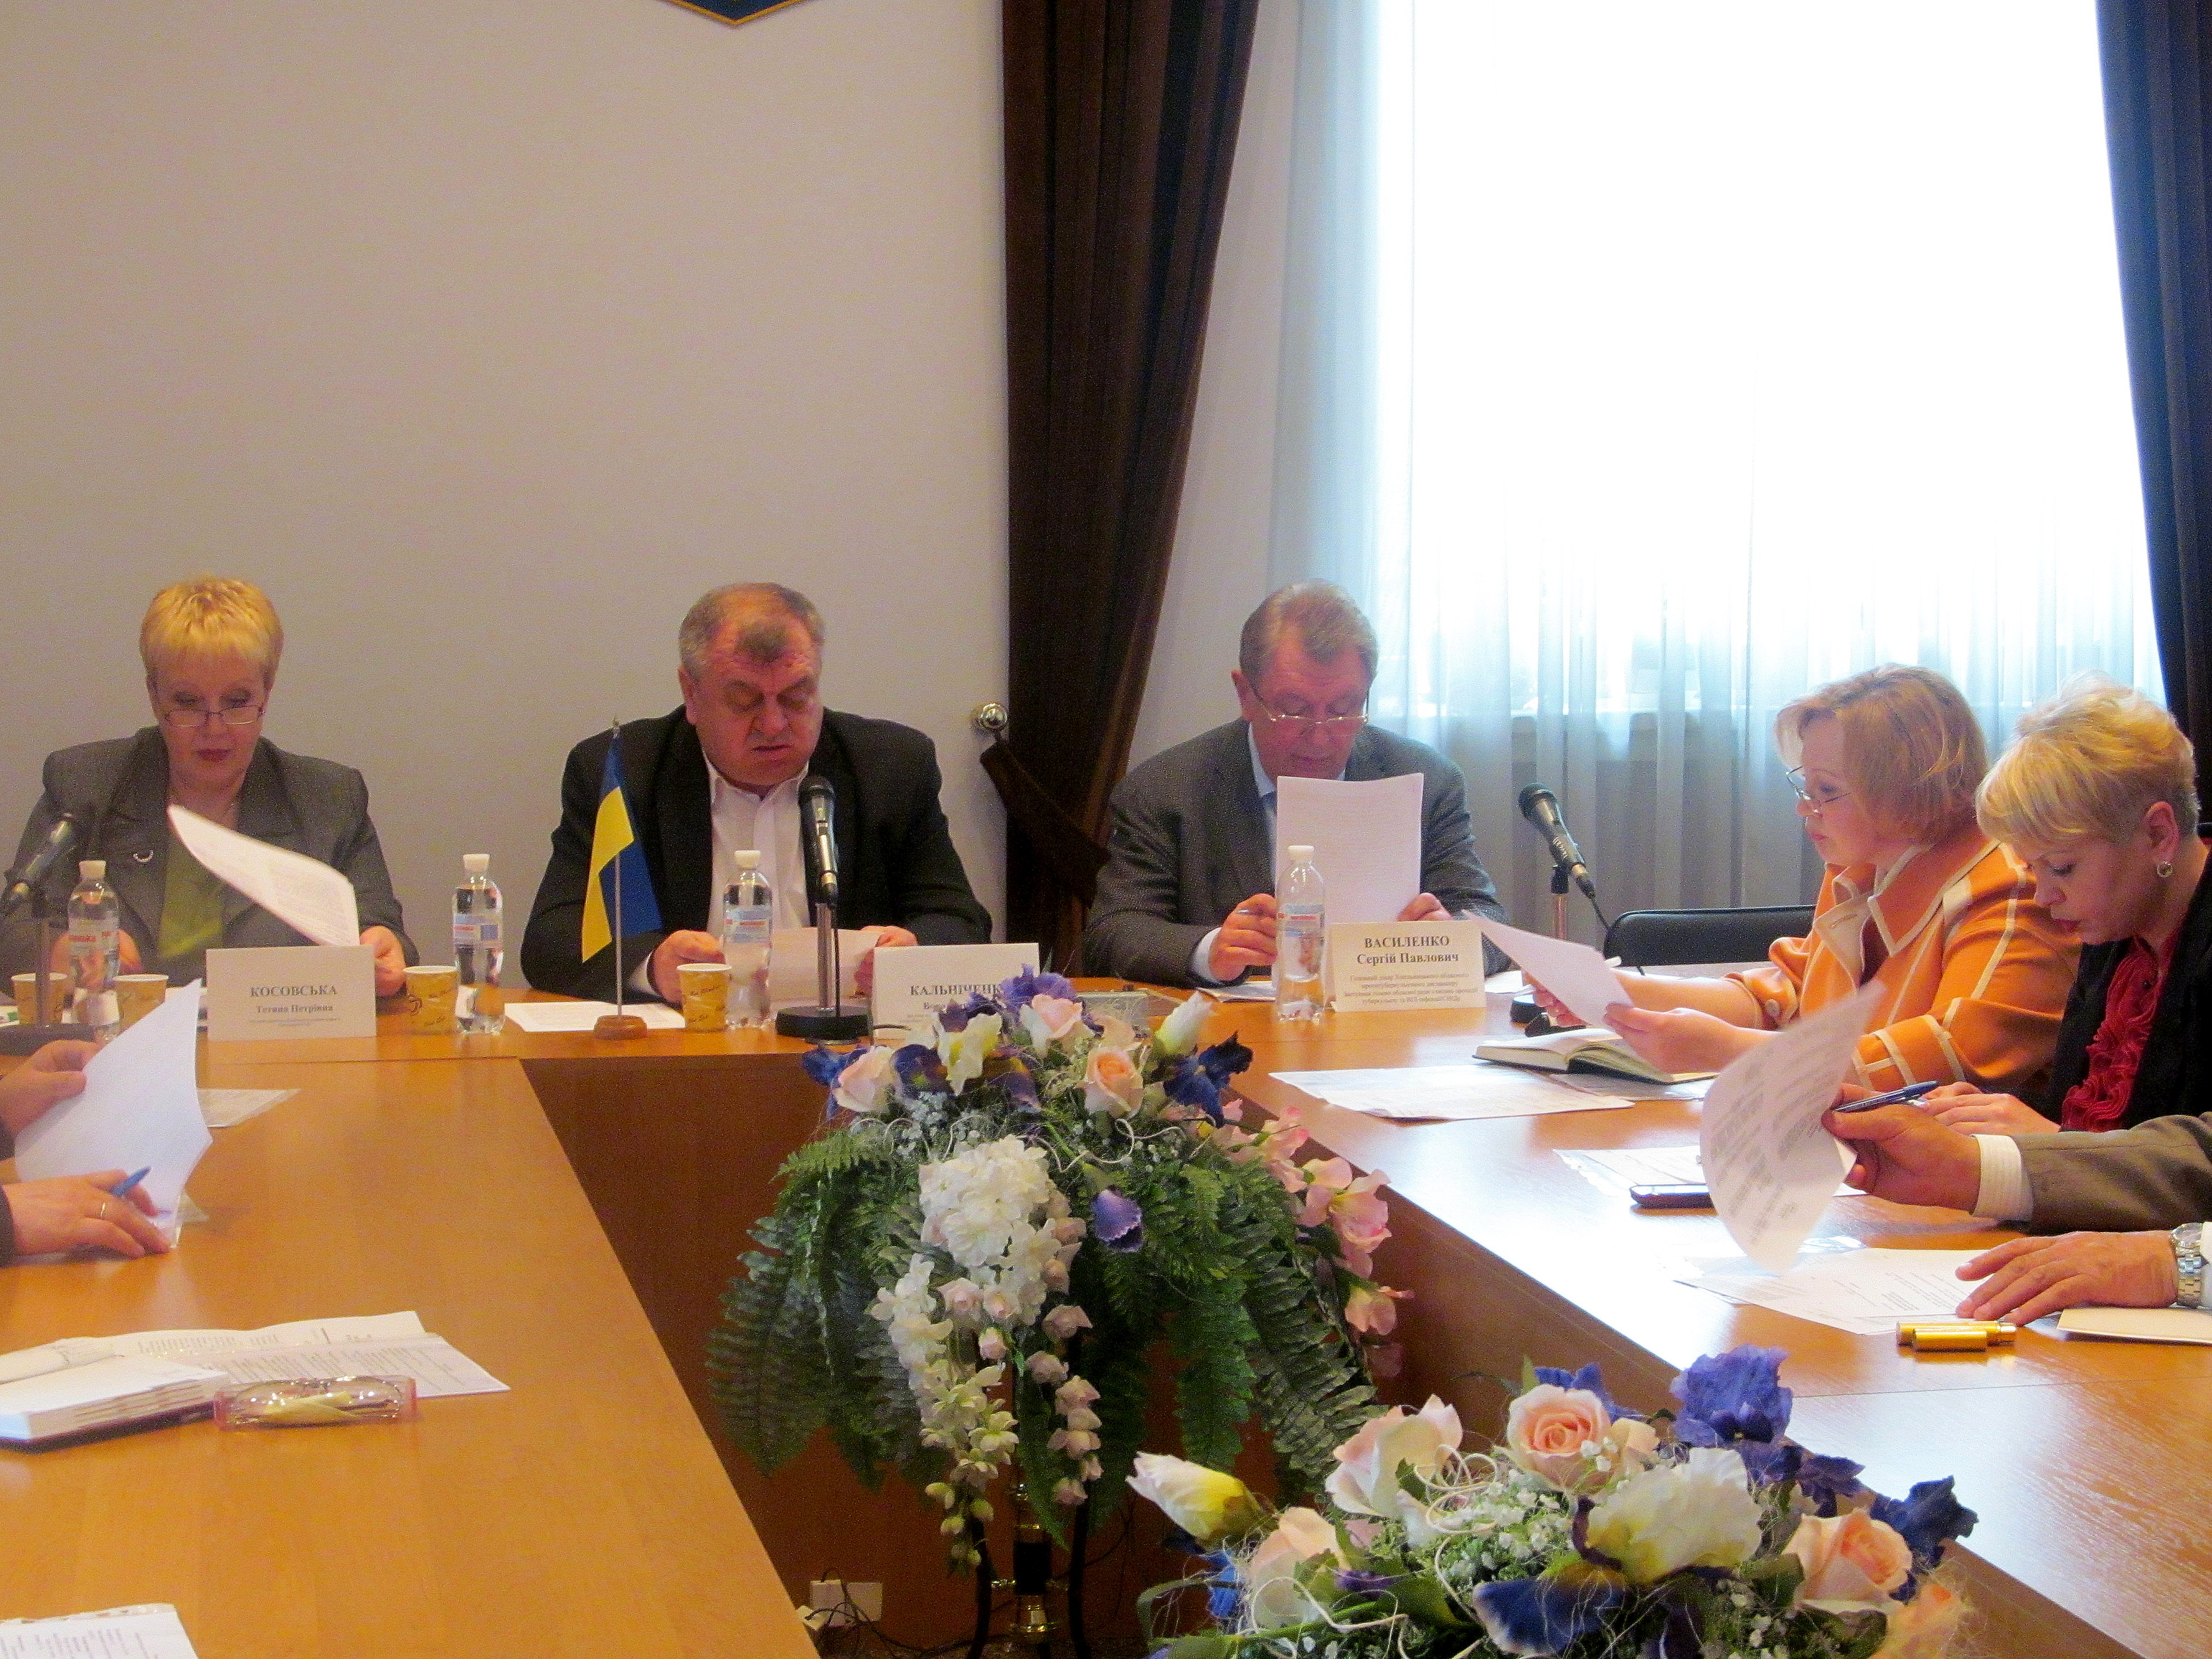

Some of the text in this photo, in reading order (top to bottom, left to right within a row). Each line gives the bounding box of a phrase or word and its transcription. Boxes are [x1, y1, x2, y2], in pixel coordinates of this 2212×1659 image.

[1365, 936, 1450, 948] ВАСИЛЕНКО
[1357, 953, 1459, 966] Сергій Павлович
[250, 985, 337, 997] КОСОВСЬКА
[910, 983, 1002, 996] КАЛЬНІЧЕНК
